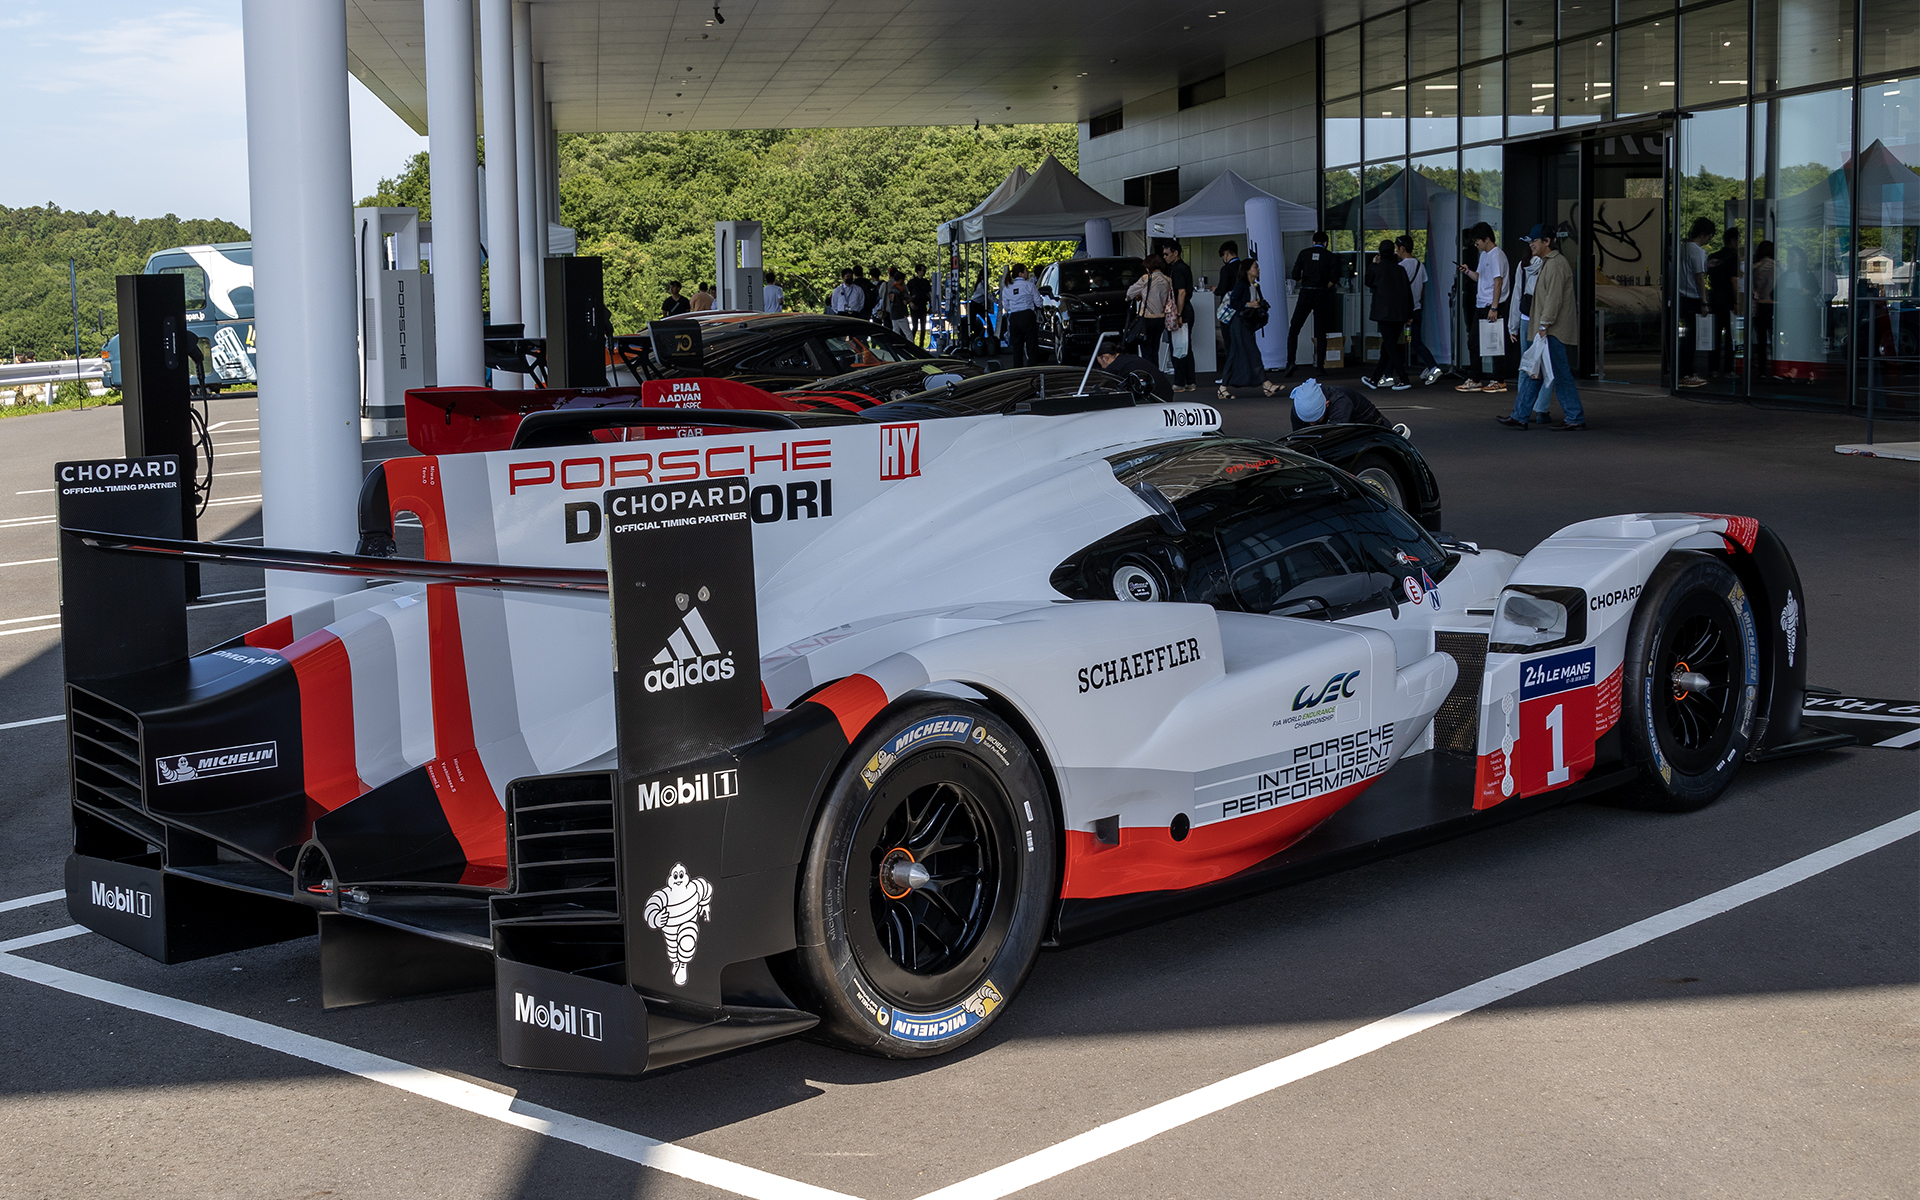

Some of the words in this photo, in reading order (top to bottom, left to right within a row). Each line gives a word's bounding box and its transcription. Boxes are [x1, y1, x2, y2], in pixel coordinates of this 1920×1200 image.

[398, 281, 407, 370] PORSCHE
[666, 394, 702, 403] ADVAN
[673, 383, 701, 392] PIAA
[1163, 409, 1202, 427] Mobil
[508, 439, 832, 496] PORSCHE
[881, 426, 920, 477] HY
[60, 460, 178, 482] CHOPARD
[1226, 464, 1243, 475] 919
[62, 485, 103, 495] OFFICIAL
[104, 483, 137, 493] TIMING
[138, 481, 178, 491] PARTNER
[611, 484, 747, 517] CHOPARD
[614, 521, 659, 534] OFFICIAL
[660, 516, 697, 530] TIMING
[698, 511, 748, 525] PARTNER
[1590, 584, 1642, 611] CHOPARD
[212, 650, 248, 662] DMG
[1742, 611, 1757, 681] MICHELIN
[644, 656, 736, 693] adidas
[1077, 637, 1201, 693] SCHAEFFLER
[1524, 664, 1545, 688] 24h
[1546, 669, 1560, 682] LE
[1560, 661, 1591, 679] MANS
[1291, 669, 1361, 711] WEC
[1271, 719, 1282, 728] FIA
[1282, 714, 1302, 725] WORLD
[1302, 705, 1337, 720] ENDURANCE
[1294, 714, 1335, 730] CHAMPIONSHIP
[895, 720, 970, 752] MICHELIN
[985, 734, 1008, 755] MICHELIN
[1293, 722, 1394, 764] PORSCHE
[1545, 703, 1569, 786] 1
[197, 747, 274, 770] MICHELIN
[1257, 740, 1393, 791] INTELLIGENT
[637, 772, 710, 812] Mobil
[1222, 757, 1390, 818] PERFORMANCE
[91, 880, 135, 914] Mobil
[825, 888, 837, 942] MICHELIN
[514, 991, 577, 1035] Mobil
[893, 1012, 968, 1037] MICHELIN
